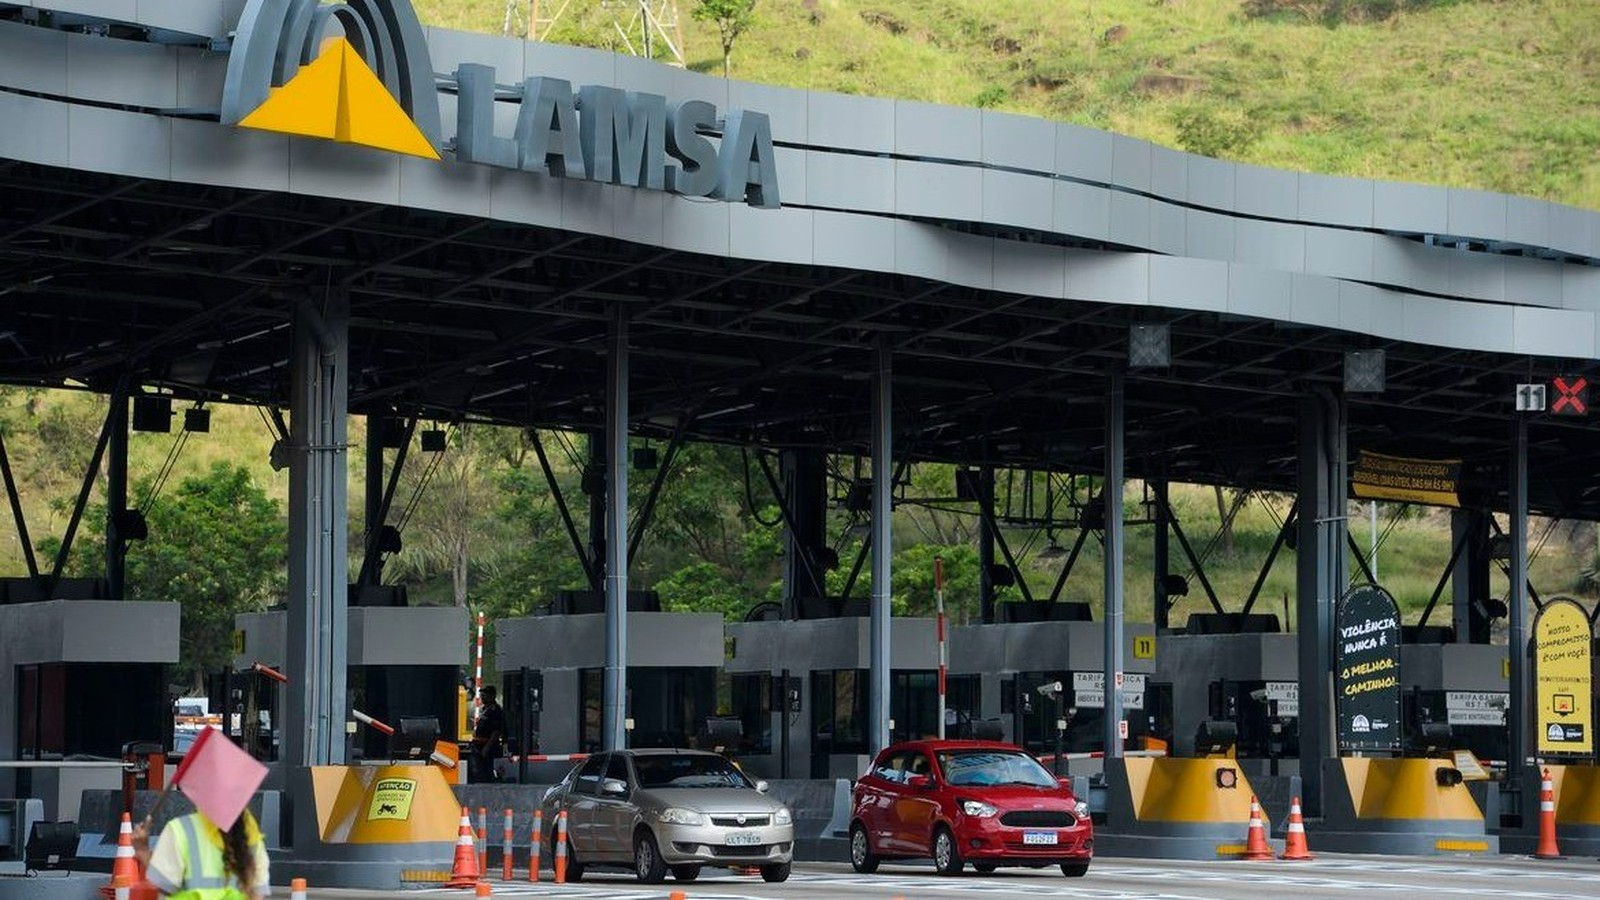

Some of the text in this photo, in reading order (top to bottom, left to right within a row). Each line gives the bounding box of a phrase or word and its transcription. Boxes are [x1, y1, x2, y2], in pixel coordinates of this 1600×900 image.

[457, 62, 781, 209] LAMSA
[1519, 385, 1544, 409] 11
[1340, 618, 1396, 639] VIOLÊNCIA
[1548, 625, 1571, 635] NOSSO
[1139, 641, 1150, 654] 11
[1344, 632, 1387, 655] NUNCA É
[1538, 633, 1590, 650] COMPROMISSO
[1549, 651, 1565, 662] COM
[1342, 658, 1395, 680] O MELHOR
[1344, 676, 1396, 696] CAMINHO!
[1450, 693, 1478, 701] TARIFA
[380, 782, 410, 791] ATENÇÃO
